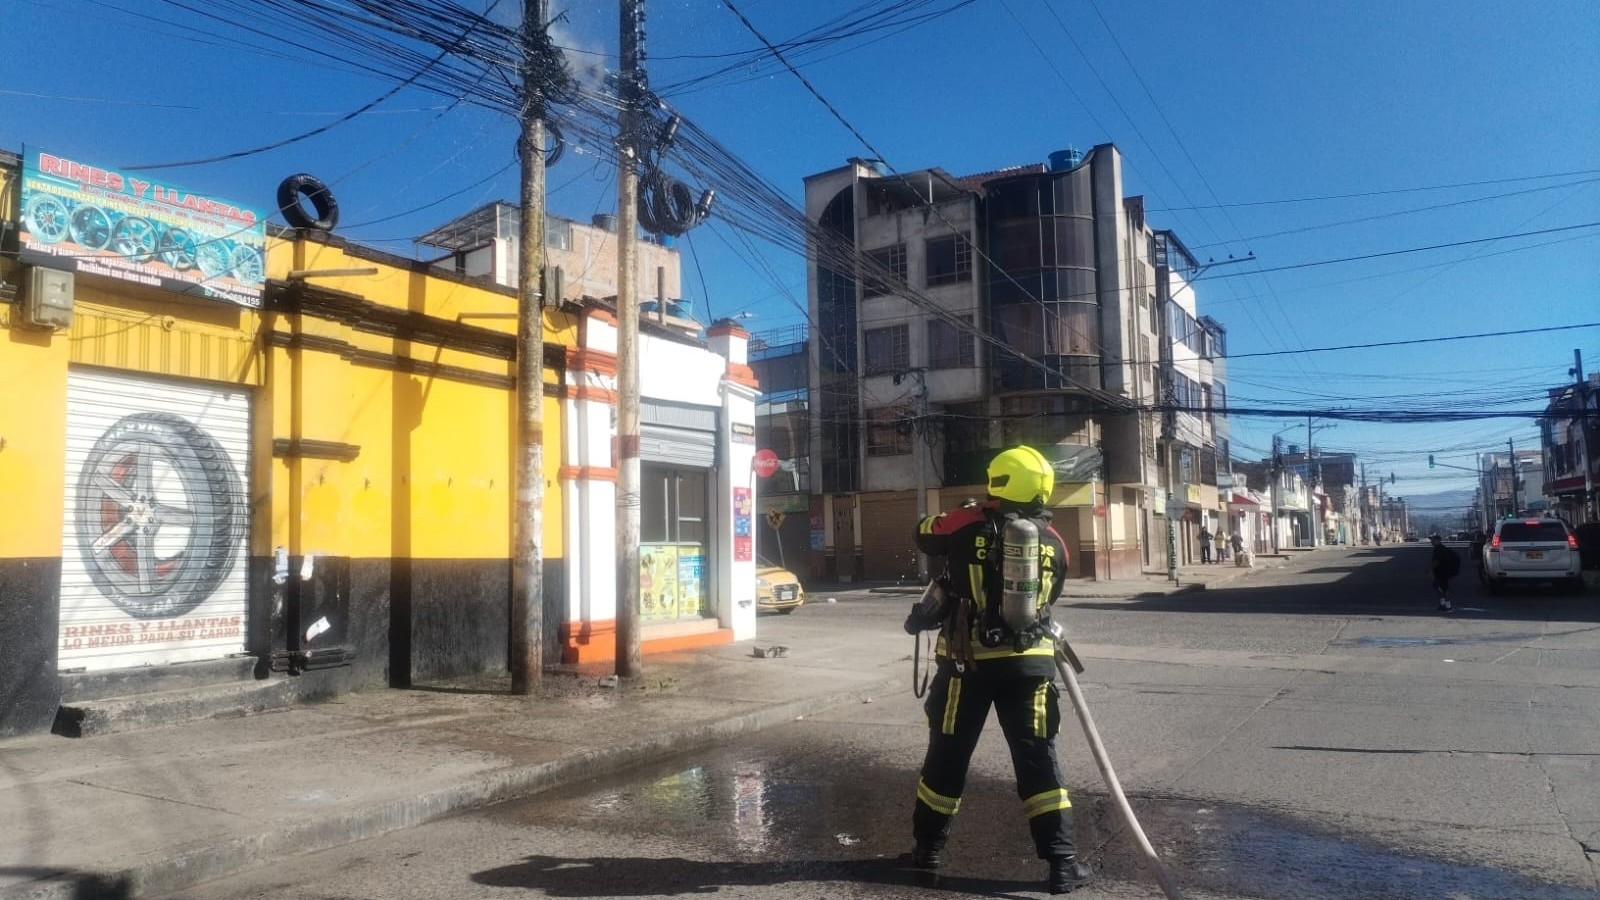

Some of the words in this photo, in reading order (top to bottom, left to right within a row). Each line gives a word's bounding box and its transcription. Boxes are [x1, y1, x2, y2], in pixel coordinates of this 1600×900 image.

[40, 153, 124, 192] RINES
[128, 178, 150, 197] Y
[154, 185, 256, 226] LLANTAS
[65, 622, 131, 637] RINES
[138, 622, 150, 632] Y
[158, 616, 241, 633] LLANTAS
[64, 638, 82, 650] LO
[88, 634, 134, 648] MEJOR
[140, 630, 174, 643] PARA
[179, 629, 195, 641] SU
[200, 627, 240, 639] CARRO
